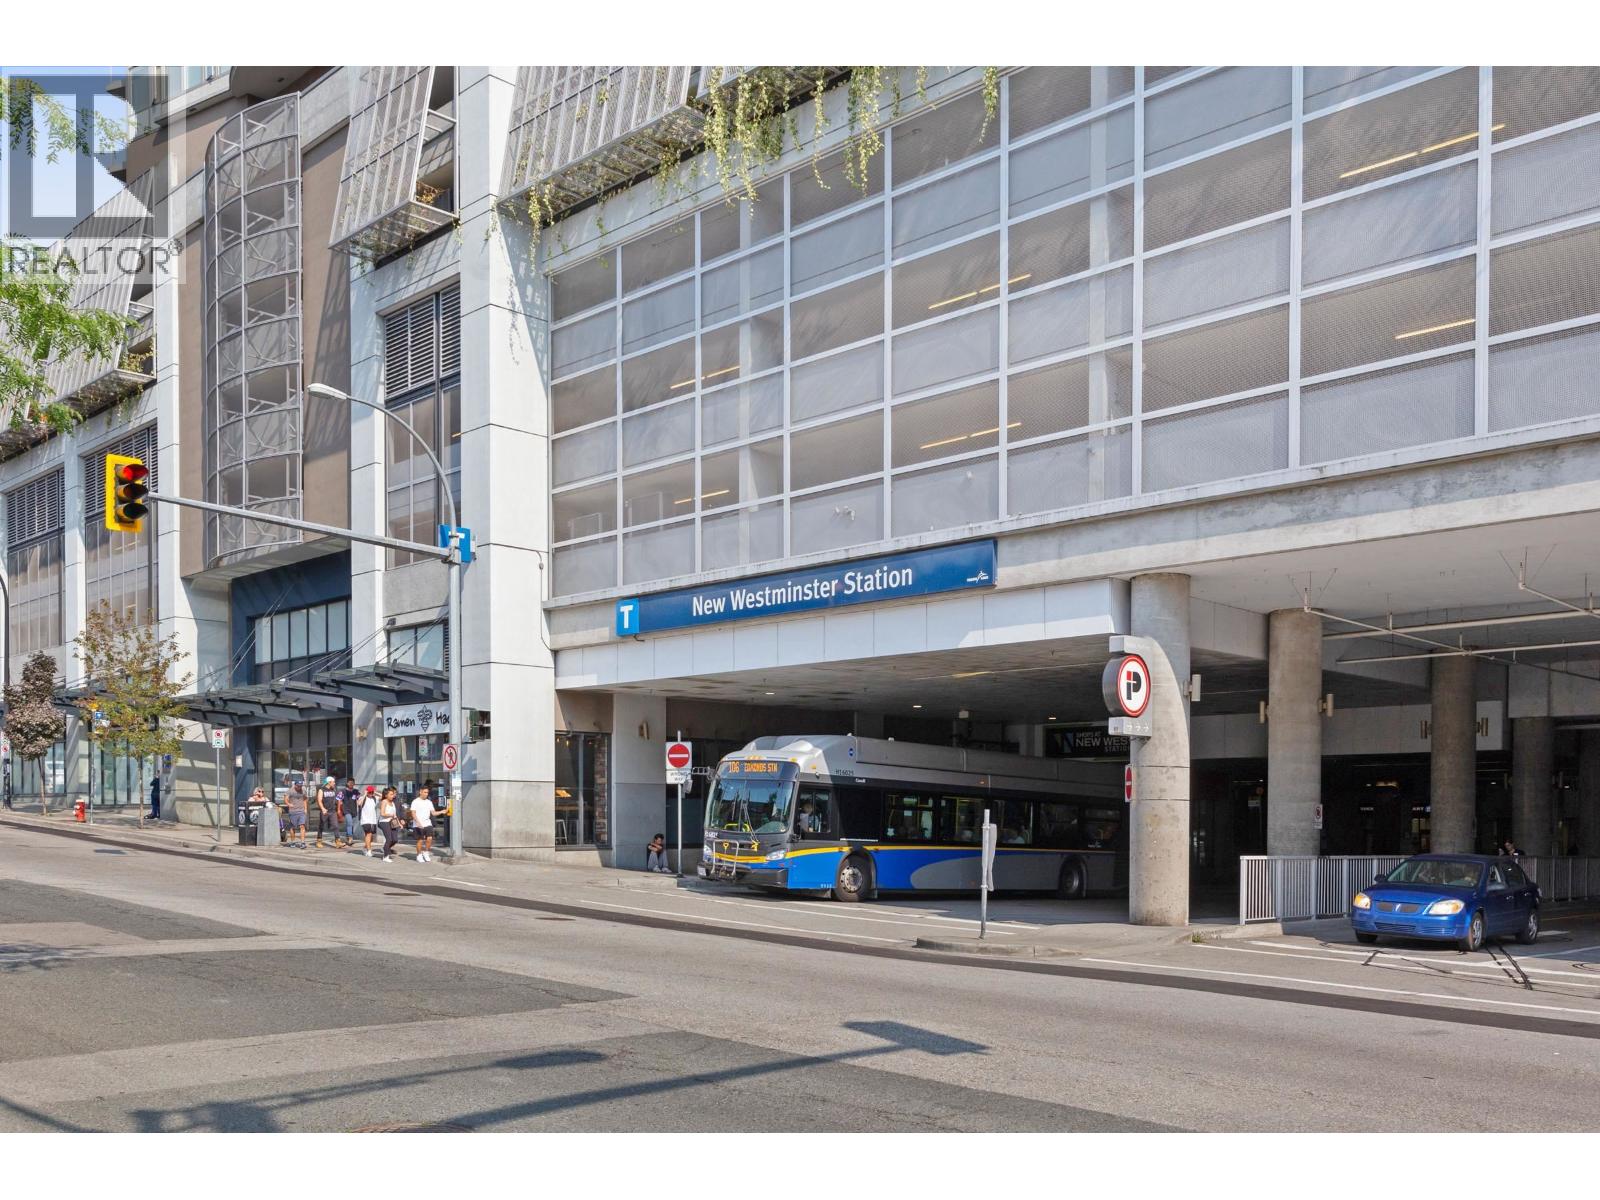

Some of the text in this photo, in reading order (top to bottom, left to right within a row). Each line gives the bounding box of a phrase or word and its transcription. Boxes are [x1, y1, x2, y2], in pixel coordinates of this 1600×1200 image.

[692, 566, 913, 617] New Westminster Station
[619, 604, 634, 629] T
[386, 717, 416, 731] Ramen
[1075, 737, 1101, 747] NEW
[728, 761, 740, 773] 106
